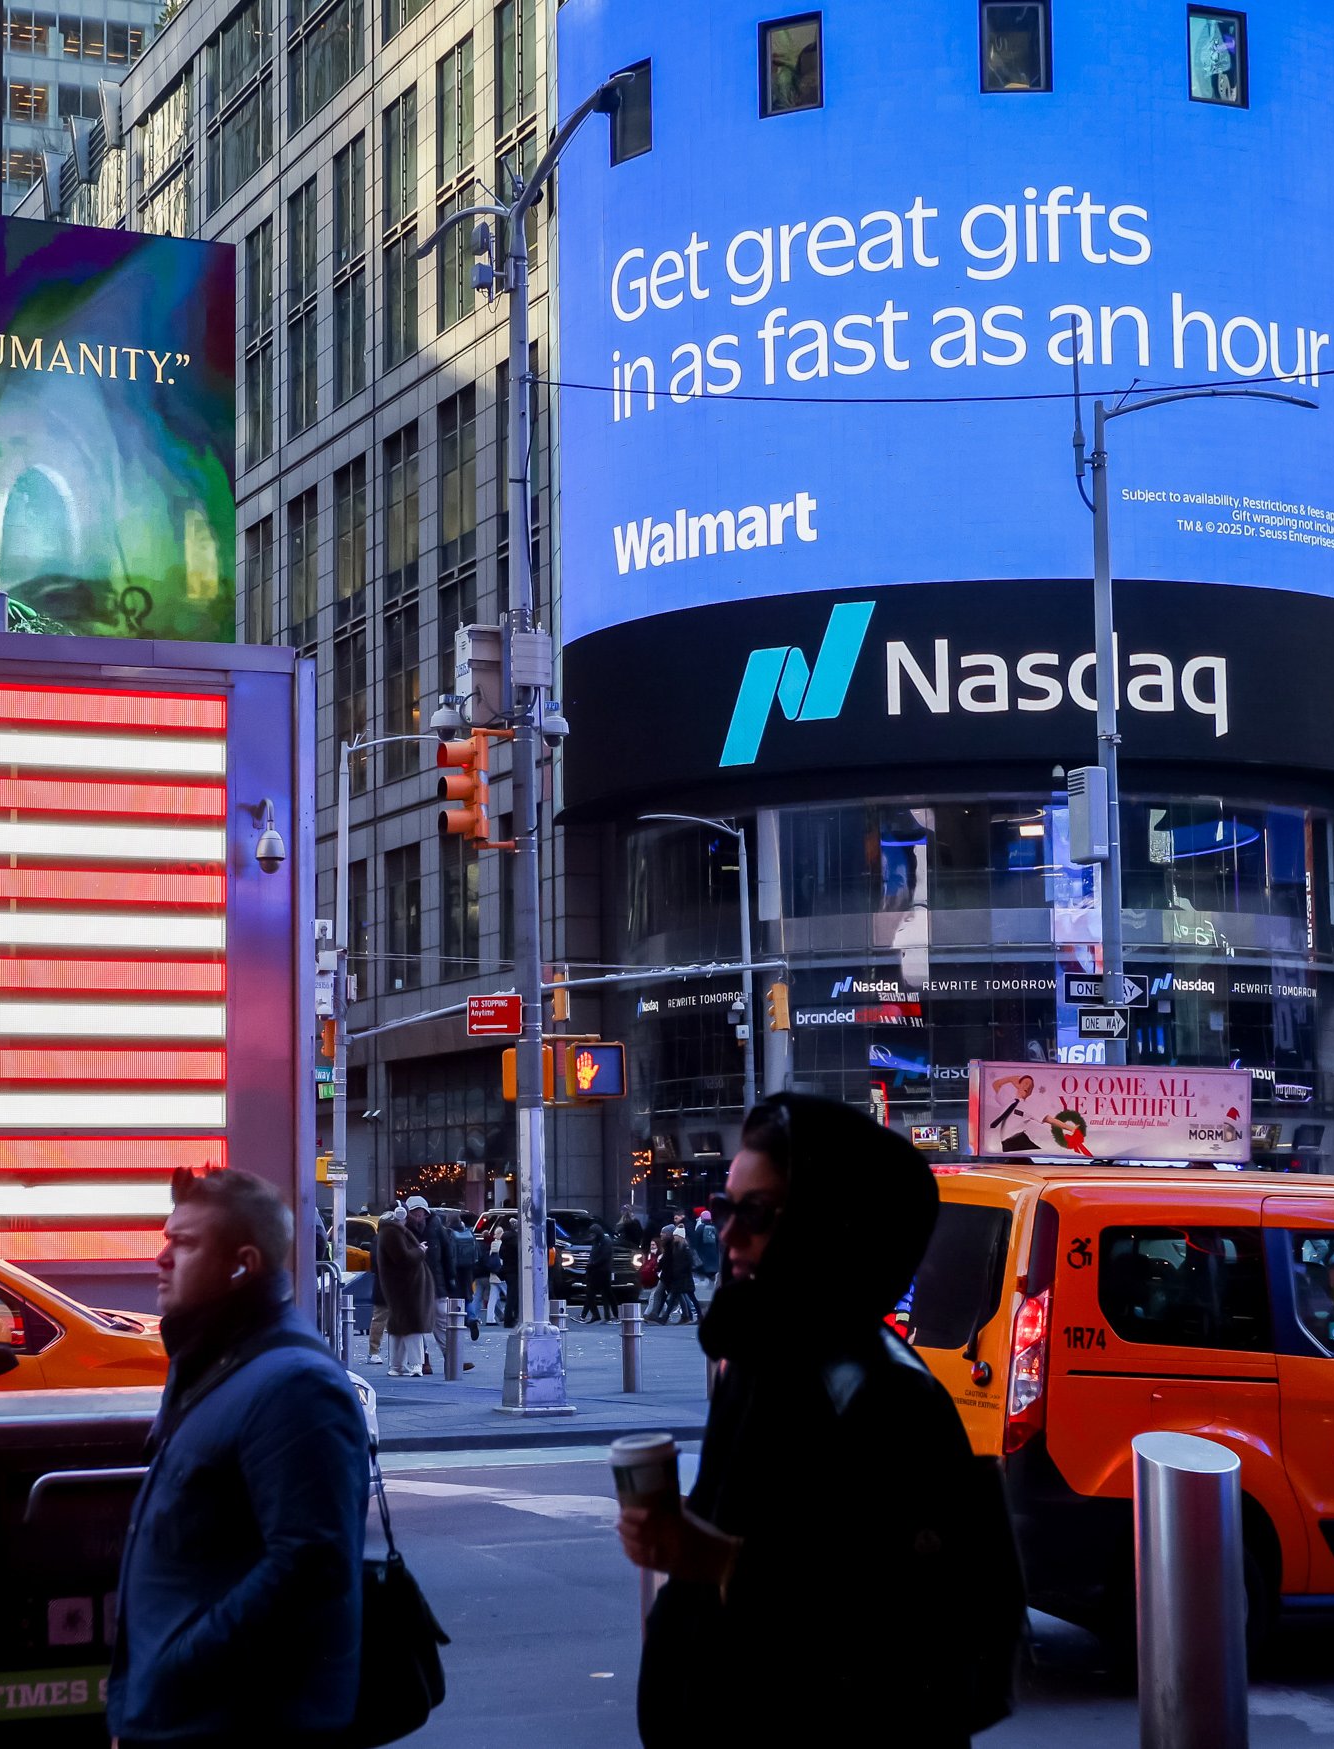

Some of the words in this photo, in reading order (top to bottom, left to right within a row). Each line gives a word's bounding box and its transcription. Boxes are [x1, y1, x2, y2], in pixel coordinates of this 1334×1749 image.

[611, 231, 710, 323] Get
[725, 196, 939, 306] great
[959, 185, 1152, 281] gifts
[612, 350, 655, 422] in
[670, 333, 742, 403] as
[757, 299, 909, 385] fast
[929, 304, 1028, 370] as
[1046, 303, 1150, 368] an
[1172, 291, 1330, 387] hour
[1122, 489, 1166, 502] Subject
[1169, 491, 1180, 502] to
[1183, 492, 1241, 509] availability.
[1243, 497, 1298, 514] Restrictions
[1299, 505, 1306, 515] &
[1307, 505, 1324, 519] fees
[1177, 519, 1194, 531] TM
[1195, 522, 1203, 532] &
[1216, 523, 1242, 535] 2025
[1244, 526, 1258, 537] Dr.
[1259, 527, 1287, 541] Seuss
[1232, 510, 1250, 522] Gift
[1252, 513, 1297, 529] wrapping
[1298, 518, 1313, 530] not
[612, 491, 817, 575] Walmart
[886, 631, 1228, 738] Nasdaq
[852, 980, 900, 993] Nasdaq
[922, 980, 978, 991] REWRITE
[985, 979, 1057, 990] TOMORROW
[1076, 983, 1100, 996] ONE
[1173, 978, 1215, 994] Nasdaq
[1234, 983, 1272, 995] REWRITE
[1277, 984, 1317, 997] TOMORROW
[471, 1000, 479, 1008] NO
[481, 1000, 508, 1008] STOPPING
[471, 1009, 495, 1018] Anytime
[1085, 1017, 1100, 1030] ONE
[1106, 1018, 1121, 1031] WAY
[1061, 1075, 1078, 1096] O
[1084, 1076, 1146, 1097] COME
[1156, 1078, 1196, 1098] ALL
[1059, 1095, 1090, 1115] YE
[1094, 1097, 1197, 1118] FAITHFUL
[1090, 1117, 1104, 1127] and
[1105, 1117, 1116, 1127] the
[1063, 1326, 1106, 1351] 1R74
